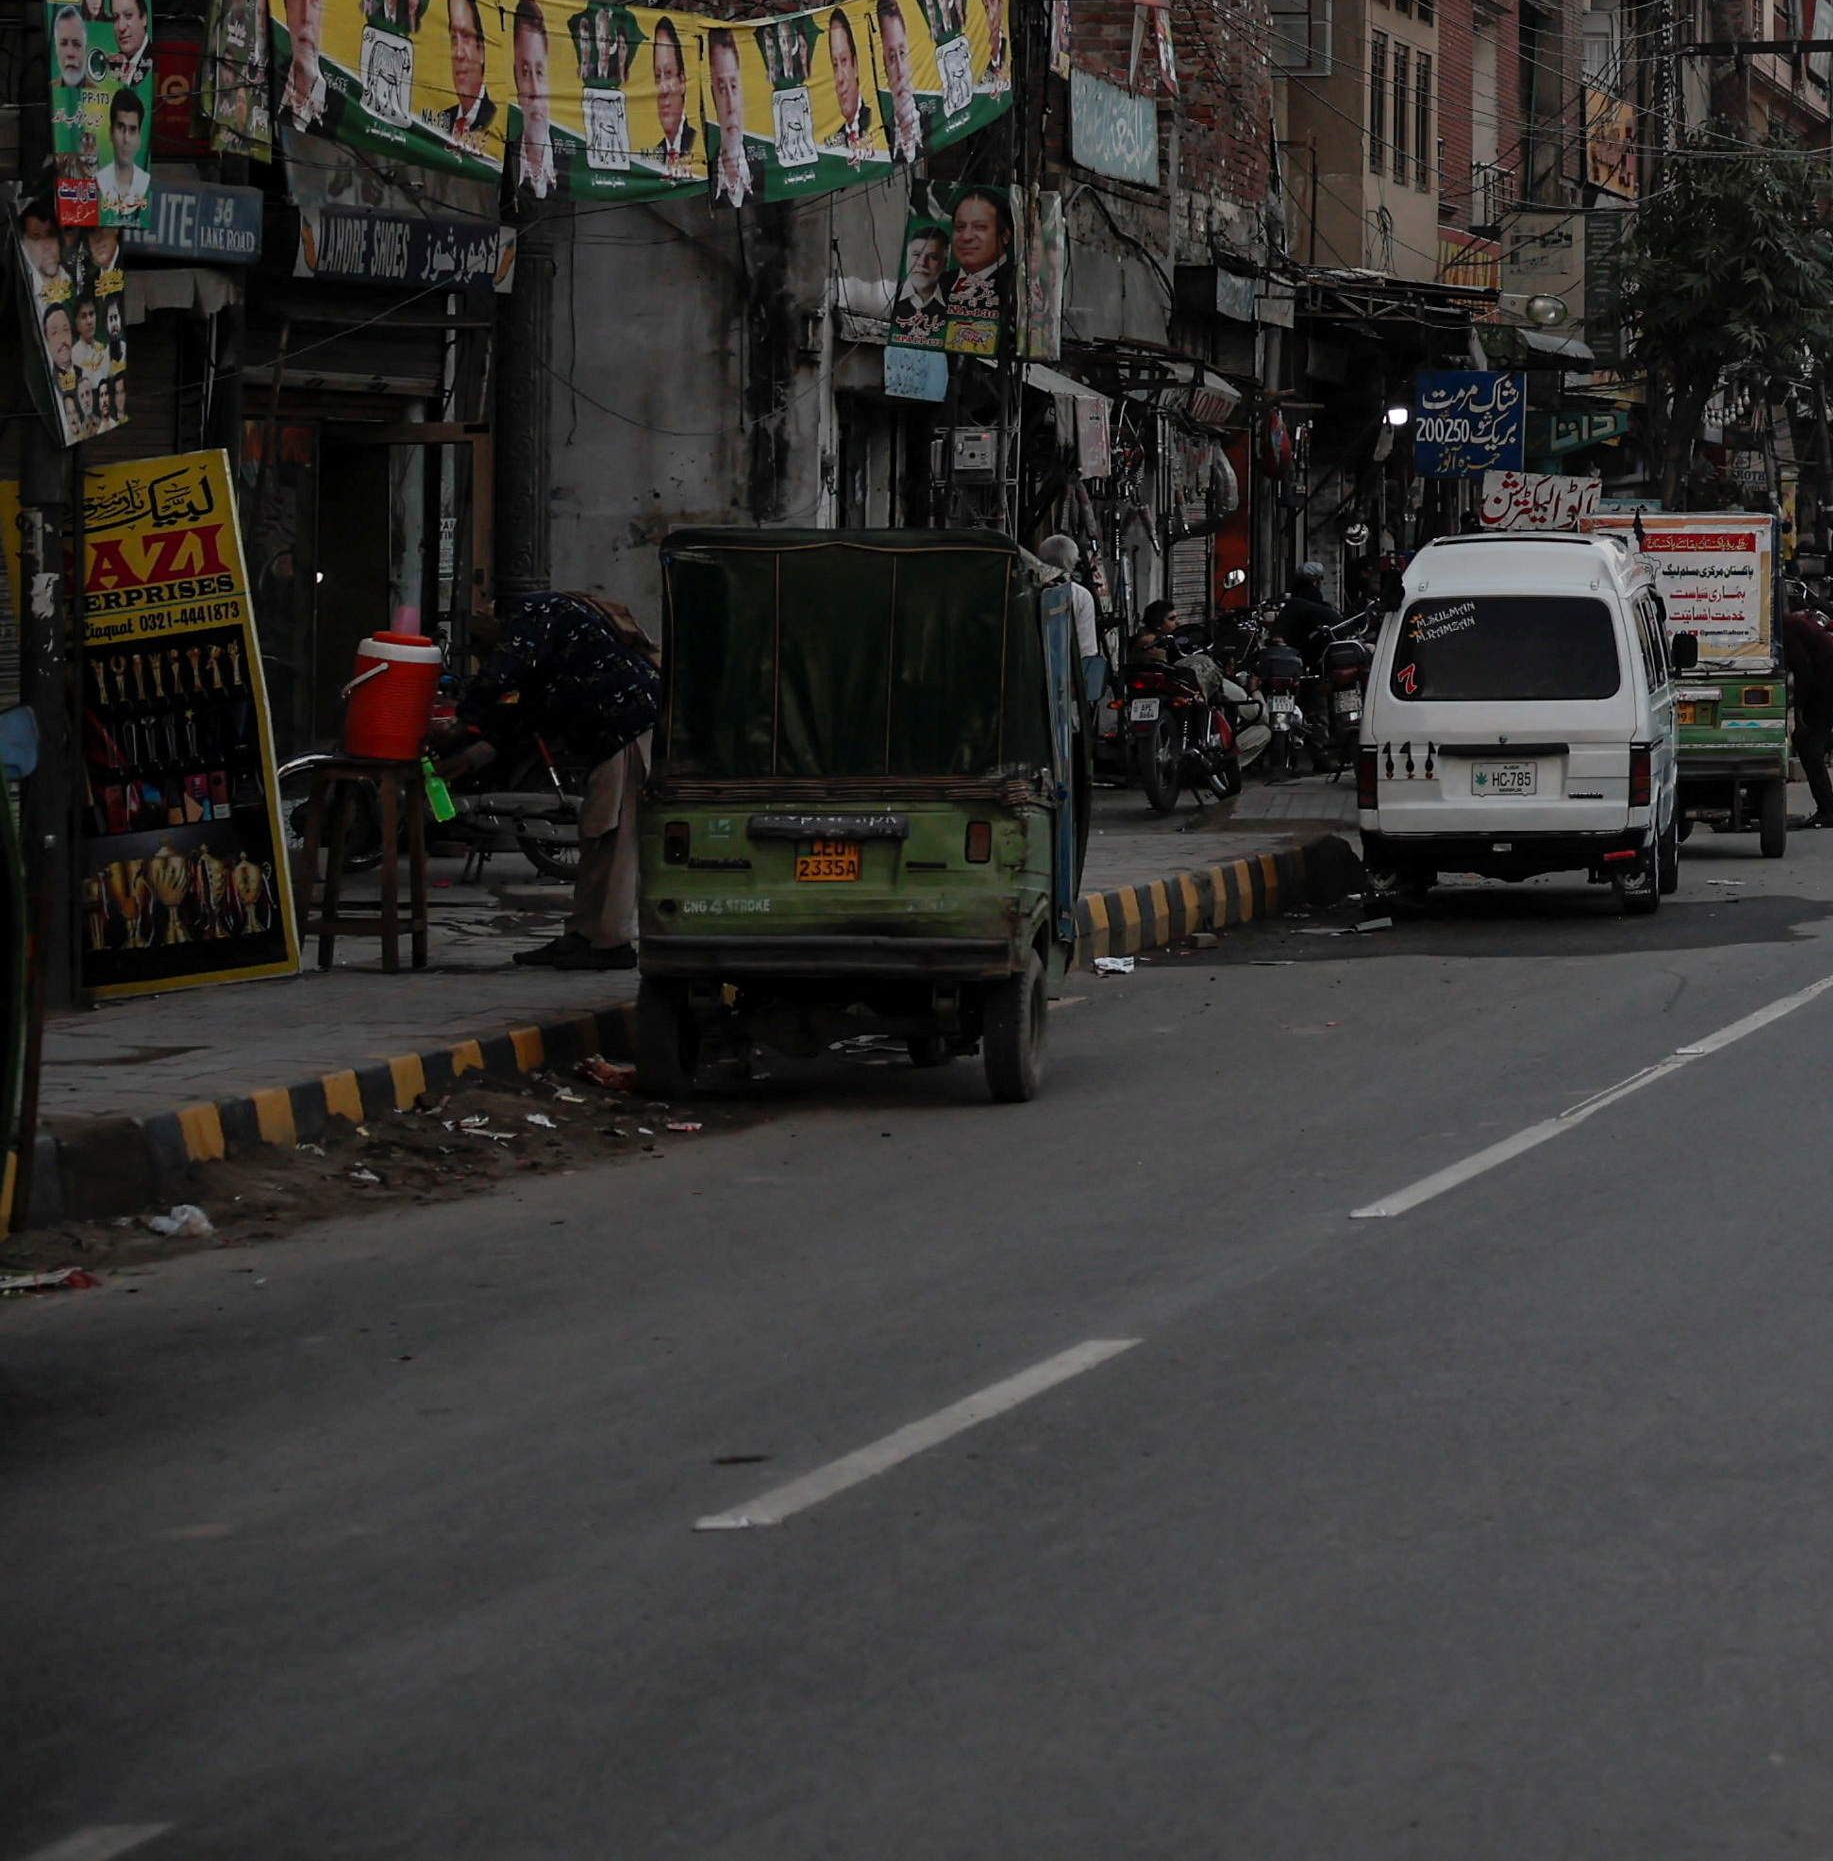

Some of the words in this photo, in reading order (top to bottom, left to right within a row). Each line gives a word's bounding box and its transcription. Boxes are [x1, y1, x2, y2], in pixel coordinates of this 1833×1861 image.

[200, 225, 225, 251] LAKE
[226, 228, 255, 253] ROAD
[316, 216, 367, 275] LAHORE
[369, 219, 411, 279] SHOES
[1722, 565, 1754, 580] پاکستان
[139, 599, 239, 632] 0321-4441873
[1415, 615, 1477, 640] M.RAMZAN
[1491, 771, 1532, 787] HC-785
[798, 859, 857, 878] 2335A
[683, 899, 708, 914] CNG
[728, 899, 771, 913] STROKE
